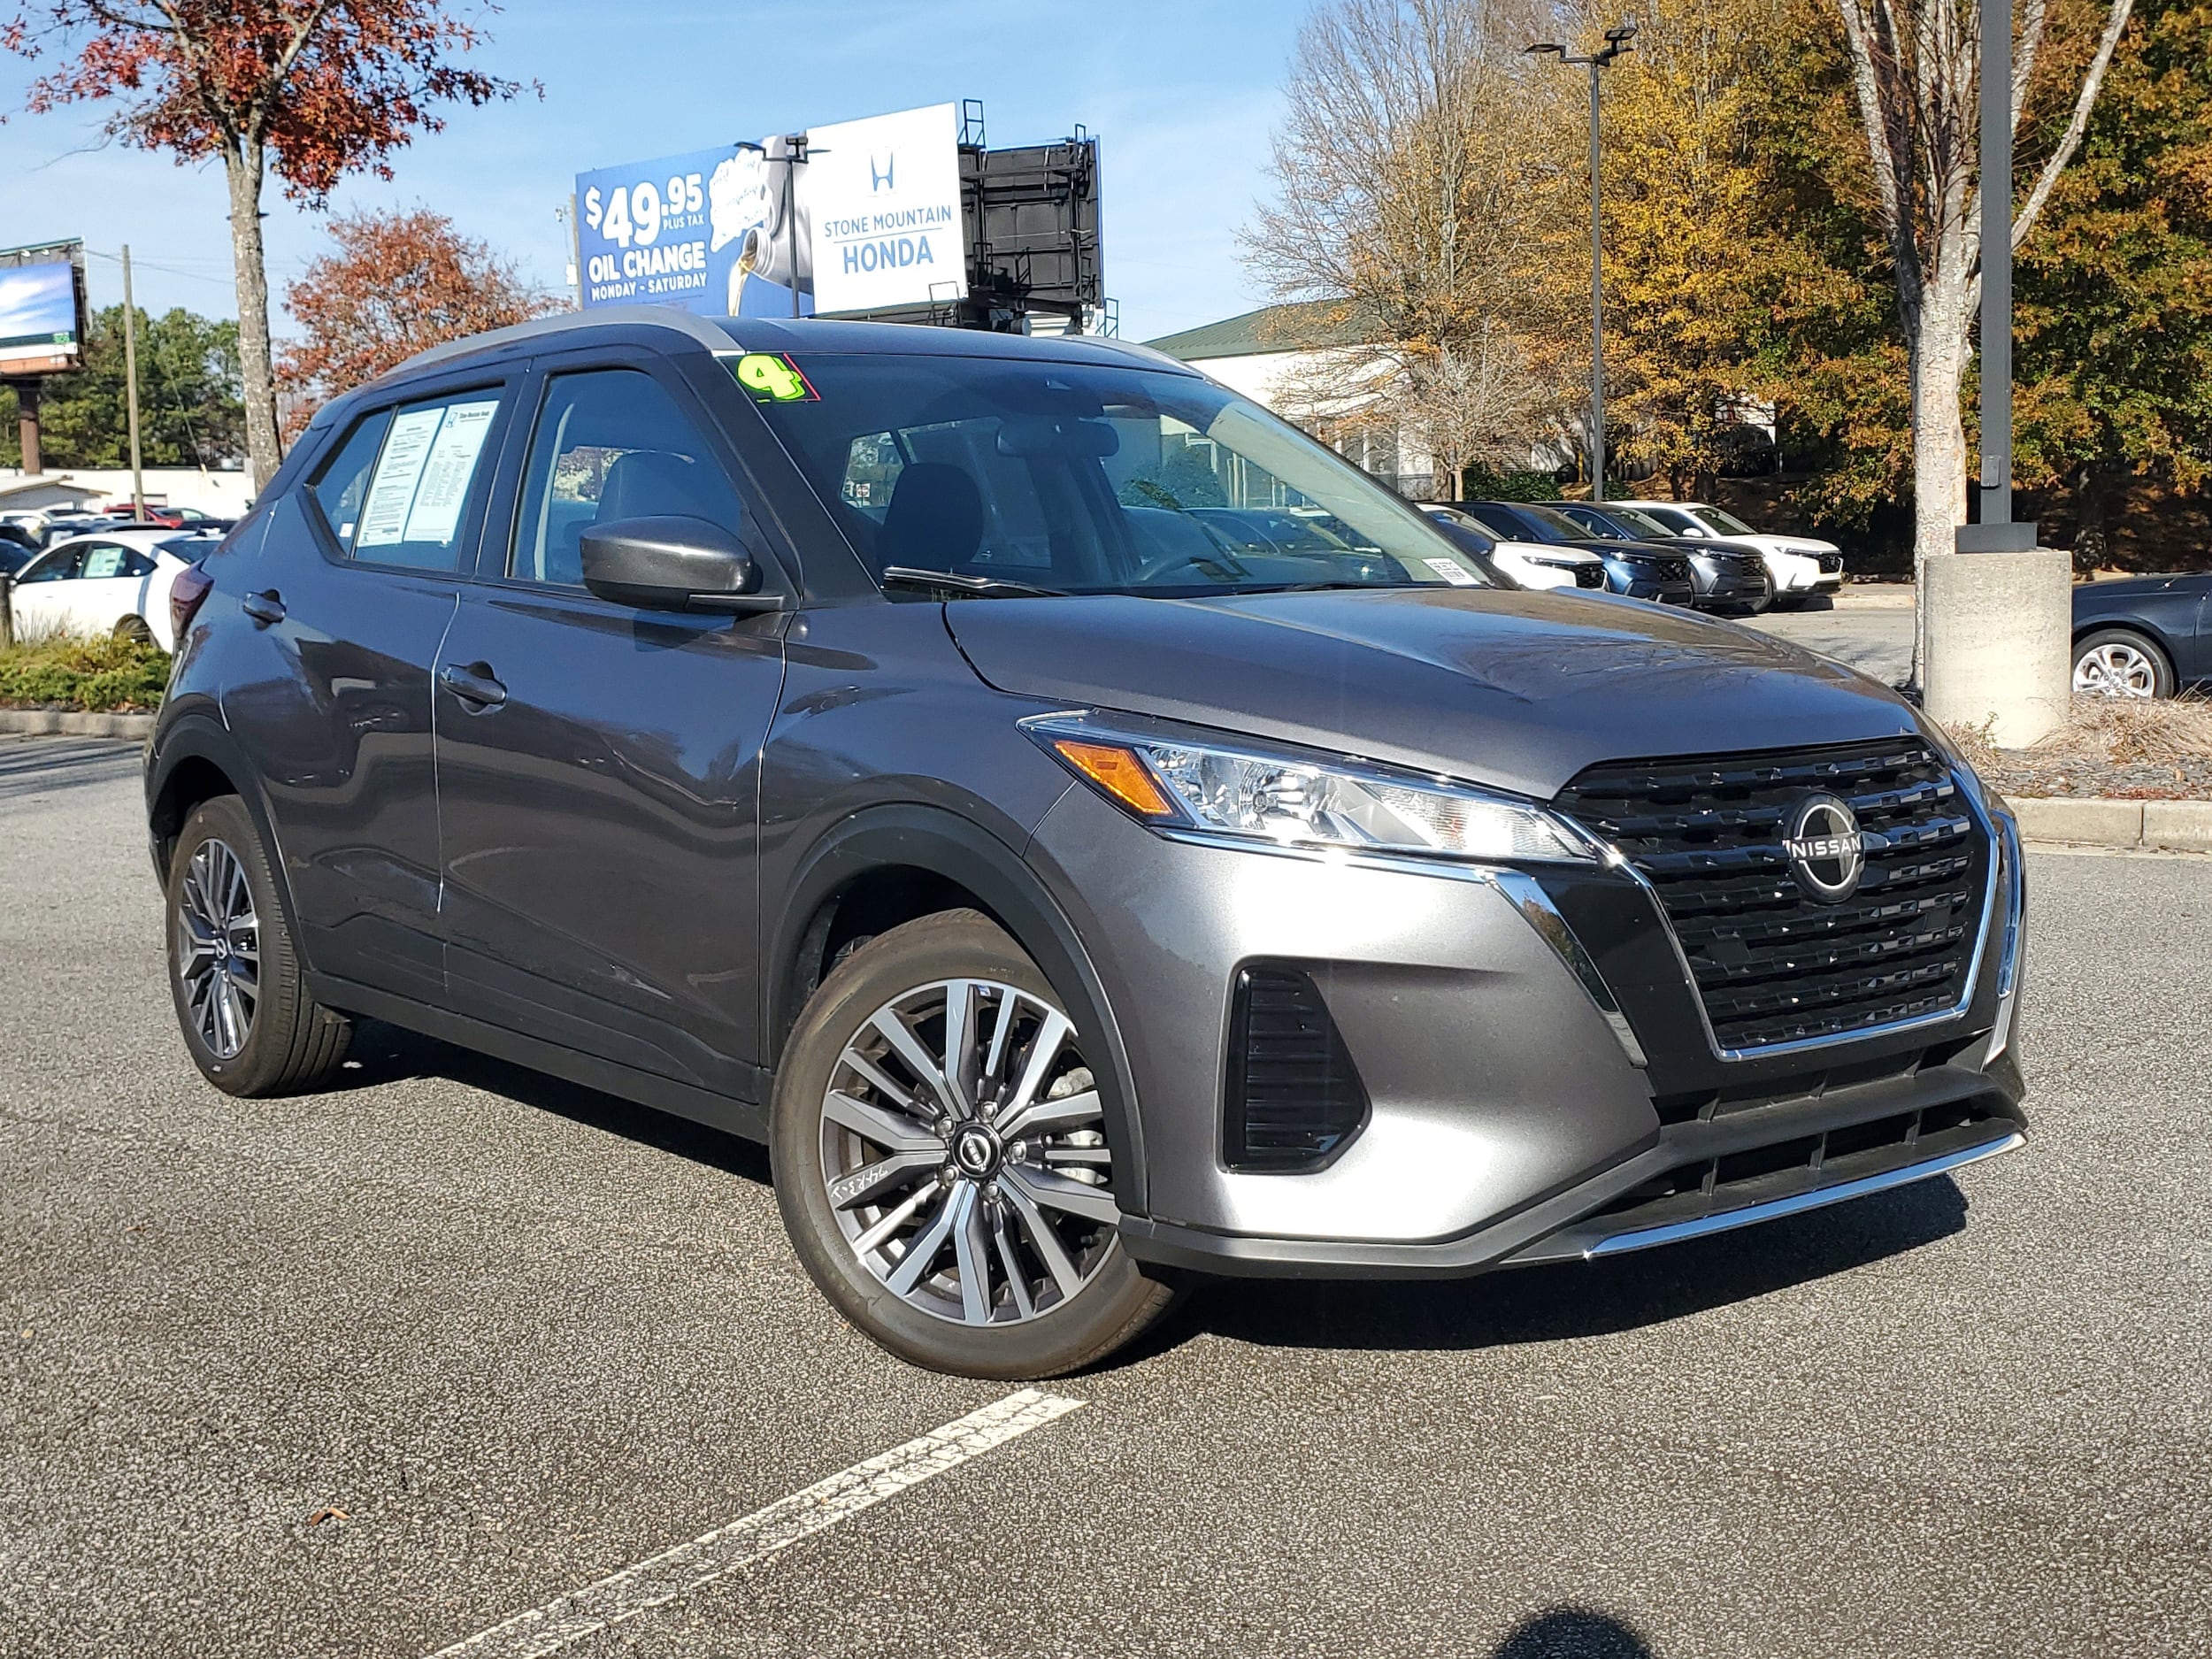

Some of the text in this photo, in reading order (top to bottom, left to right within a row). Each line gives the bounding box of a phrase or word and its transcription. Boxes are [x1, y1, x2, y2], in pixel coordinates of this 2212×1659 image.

[585, 173, 703, 248] $49.95
[664, 214, 704, 230] PLUS TAX
[825, 205, 951, 237] STONE MOUNTAIN
[588, 241, 706, 283] OIL CHANGE
[843, 235, 934, 274] HONDA
[591, 281, 636, 302] MONDAY
[647, 273, 707, 294] SATURDAY
[1791, 836, 1862, 858] NISSAN
